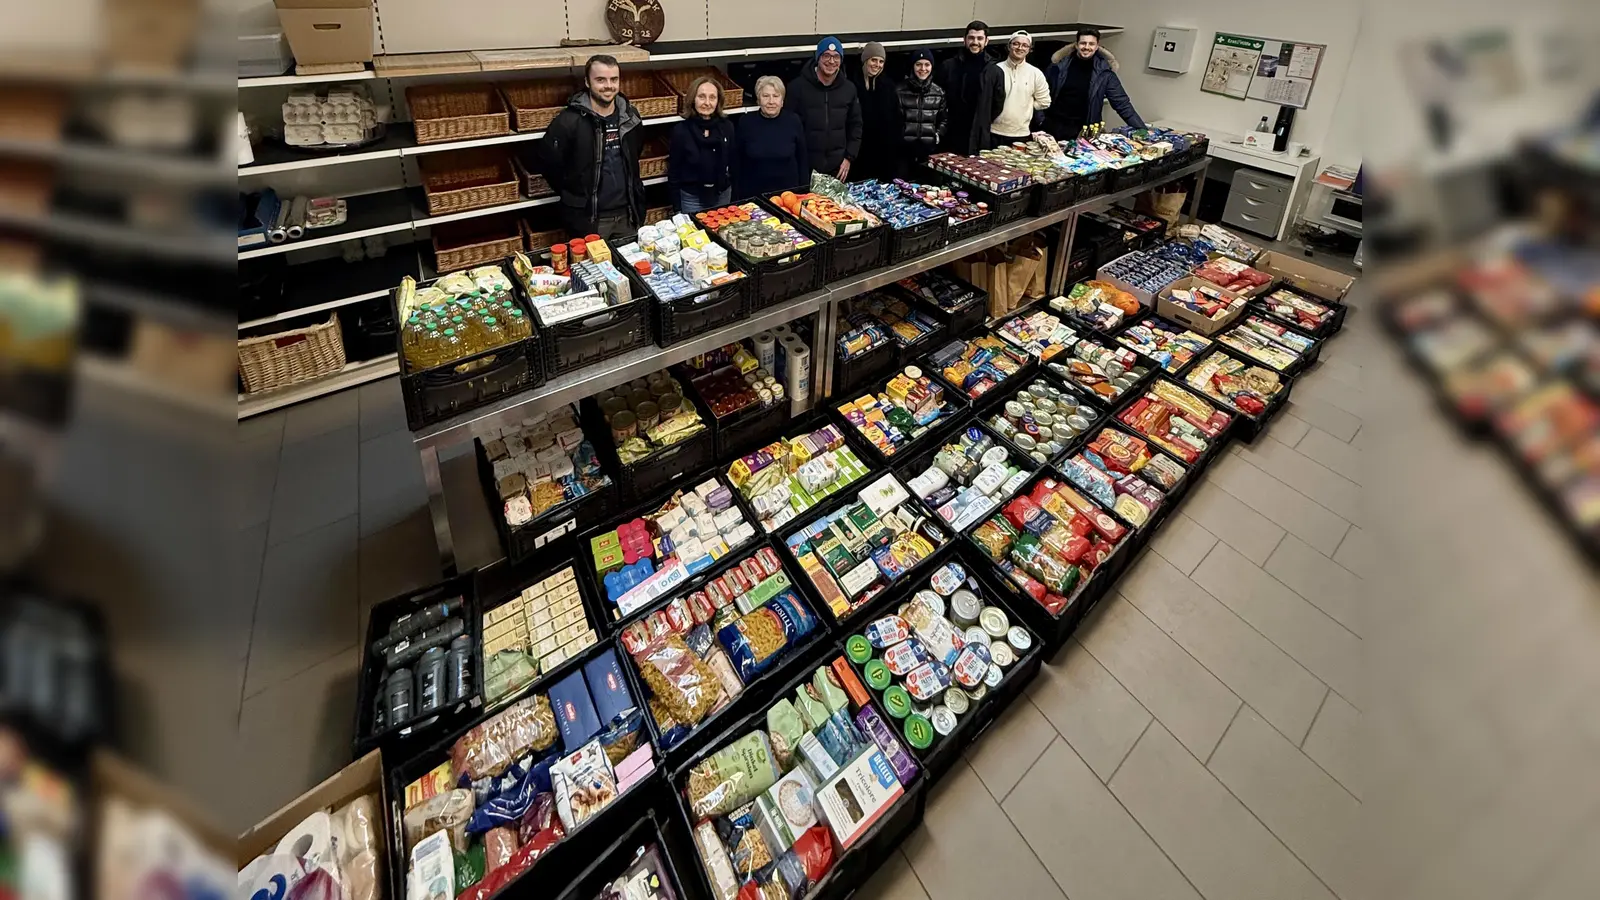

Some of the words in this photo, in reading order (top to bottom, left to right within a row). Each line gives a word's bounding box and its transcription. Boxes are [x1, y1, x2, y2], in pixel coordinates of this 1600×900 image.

[661, 570, 679, 587] DUO
[772, 602, 792, 631] FUSILLI
[746, 748, 759, 772] Dinkel
[855, 767, 877, 803] Tricolore
